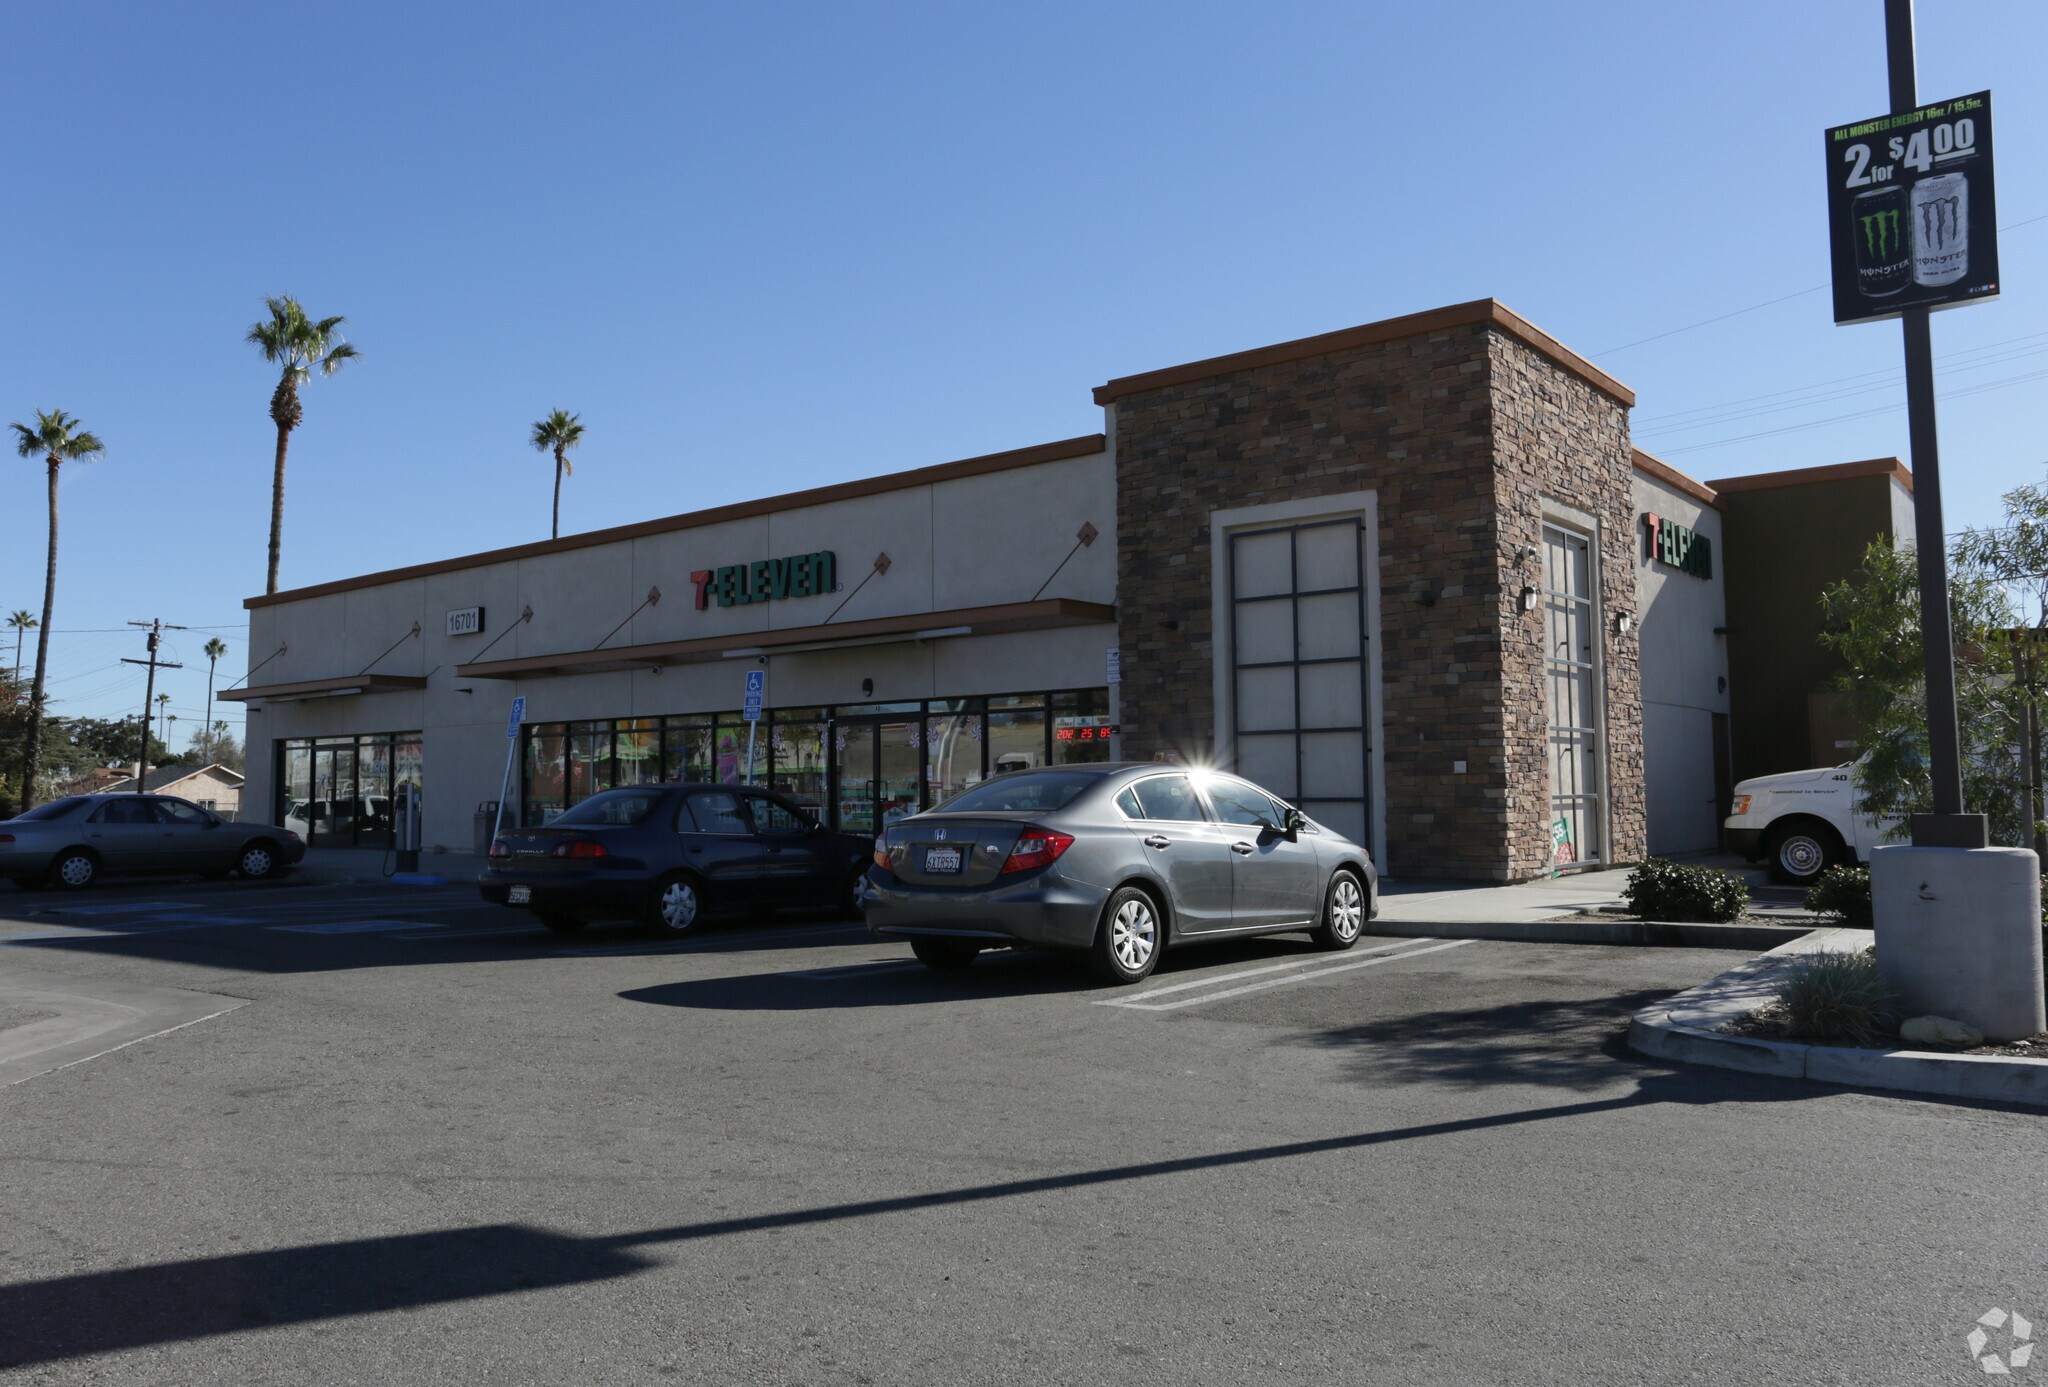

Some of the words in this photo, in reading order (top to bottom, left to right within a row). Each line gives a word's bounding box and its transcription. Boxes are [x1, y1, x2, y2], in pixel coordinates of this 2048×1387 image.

[1835, 129, 1849, 141] ALL
[1850, 119, 1890, 137] MONSTER
[1892, 111, 1924, 129] ENERGY
[1844, 143, 1871, 189] 2
[1871, 164, 1894, 183] for
[1914, 249, 1967, 265] MONSTER
[1859, 258, 1909, 276] MONSTER
[450, 611, 476, 632] 16701
[1056, 729, 1075, 739] 202
[1080, 728, 1093, 739] 25
[926, 856, 959, 869] 6XTR557
